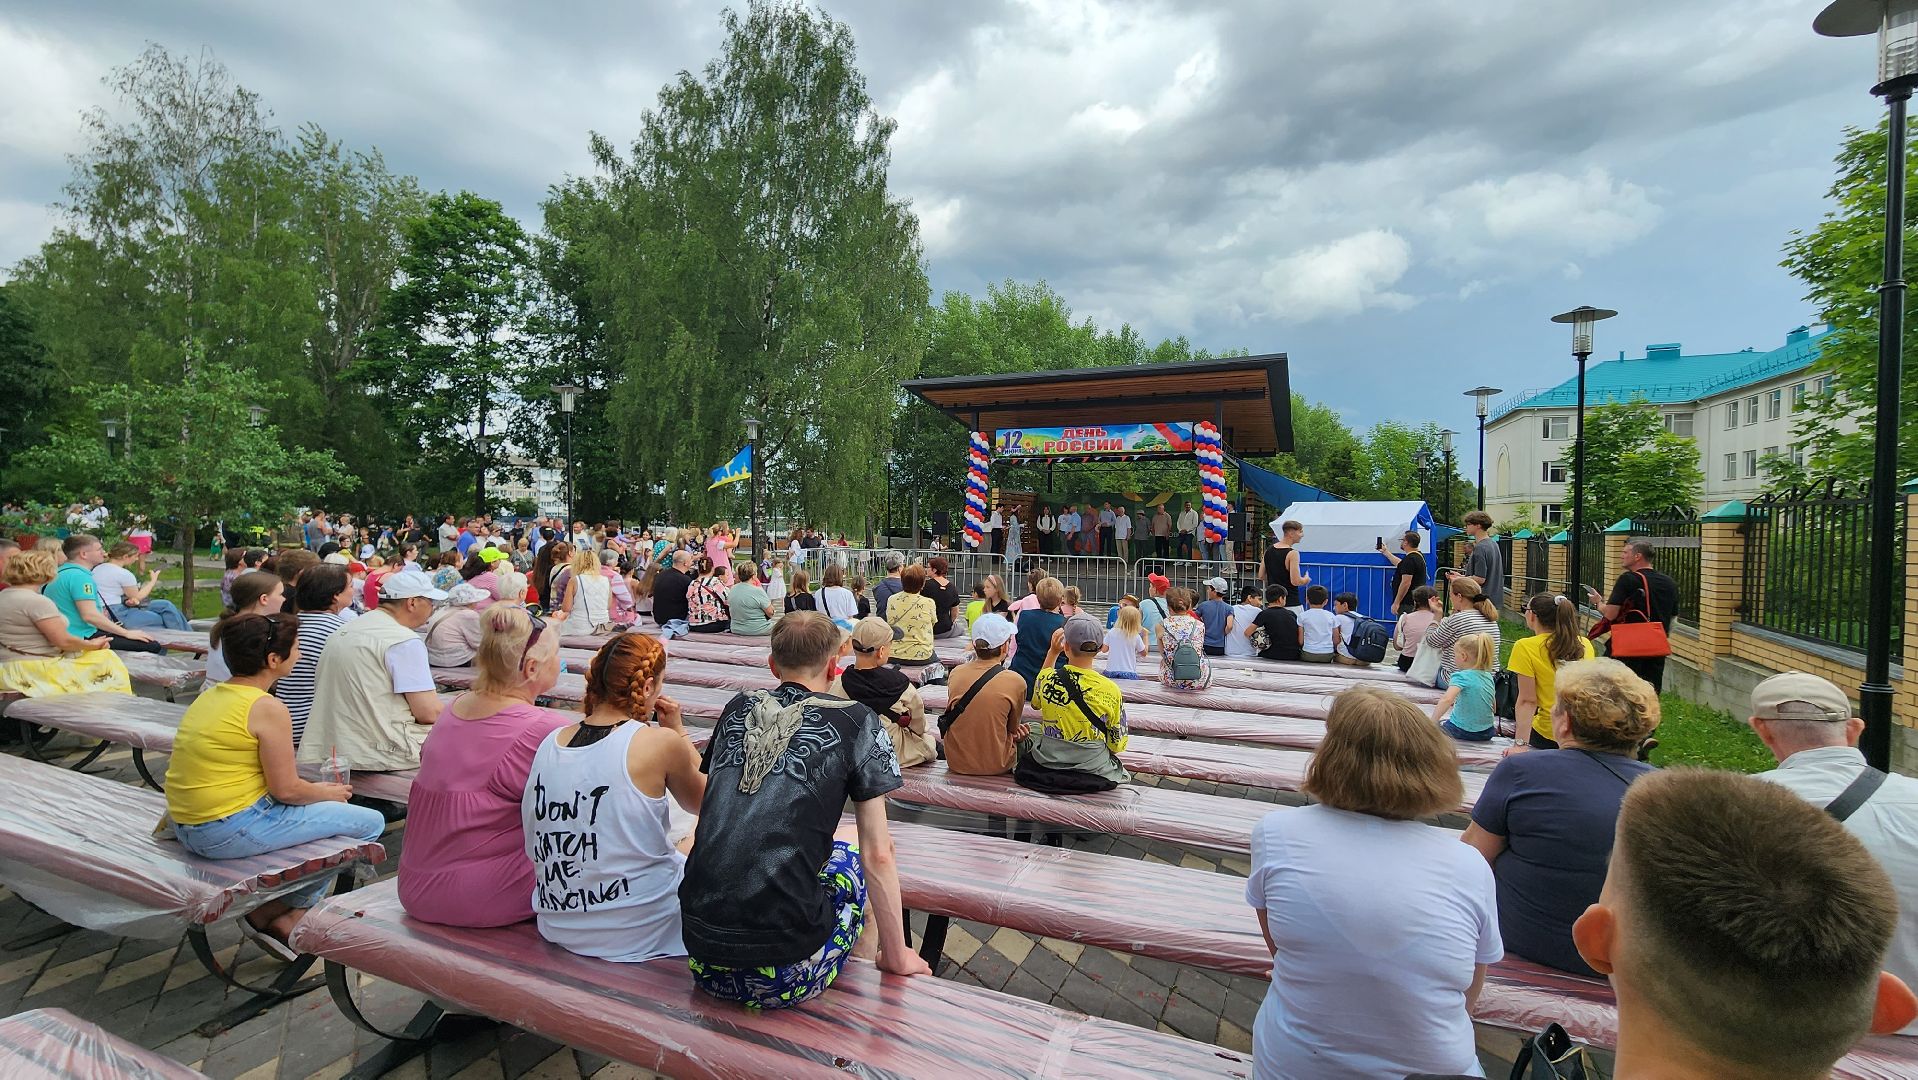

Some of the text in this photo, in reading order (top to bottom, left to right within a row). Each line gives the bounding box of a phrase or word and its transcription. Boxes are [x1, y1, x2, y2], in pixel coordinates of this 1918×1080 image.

[1003, 430, 1023, 449] 12
[1061, 427, 1107, 440] ДЕНЬ
[1043, 438, 1123, 453] РОССИИ
[537, 878, 630, 912] ANCING!
